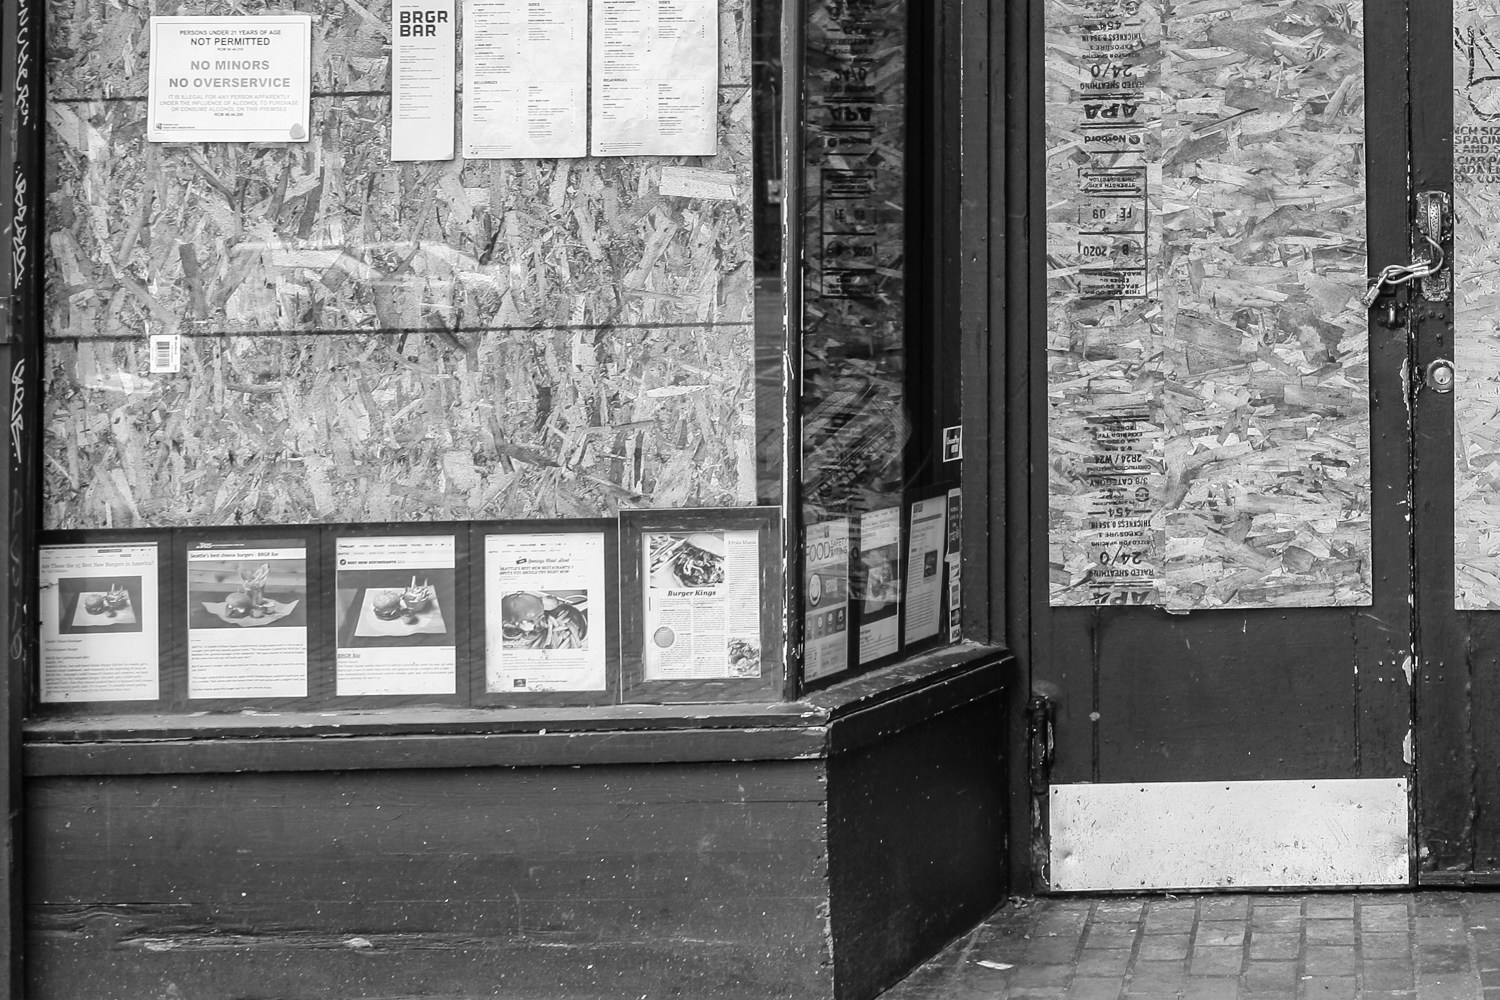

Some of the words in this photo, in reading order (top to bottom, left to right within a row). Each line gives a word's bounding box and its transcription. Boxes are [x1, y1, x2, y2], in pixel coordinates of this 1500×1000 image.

[400, 10, 448, 23] BRGR
[400, 25, 436, 37] BAR
[1108, 33, 1140, 41] THICKNESS
[190, 38, 211, 46] NOT
[214, 38, 270, 46] PERMITTED
[190, 60, 210, 70] NO
[215, 60, 270, 70] MINORS
[1090, 61, 1132, 78] 24/0
[169, 78, 189, 87] NO
[193, 78, 291, 87] OVERSERVICE
[1080, 81, 1120, 90] SHEATHING
[1084, 103, 1138, 119] APA
[1084, 135, 1126, 144] Norbord
[1463, 145, 1489, 154] AND
[1092, 209, 1106, 219] 09
[1120, 208, 1132, 219] FE
[1083, 246, 1107, 256] 2020
[1121, 454, 1142, 463] 2R24
[1090, 478, 1133, 487] CATEGORY
[1108, 508, 1132, 517] 454
[1118, 520, 1151, 528] THICKNESS
[1100, 547, 1142, 566] 24/0
[1130, 569, 1154, 577] RATED
